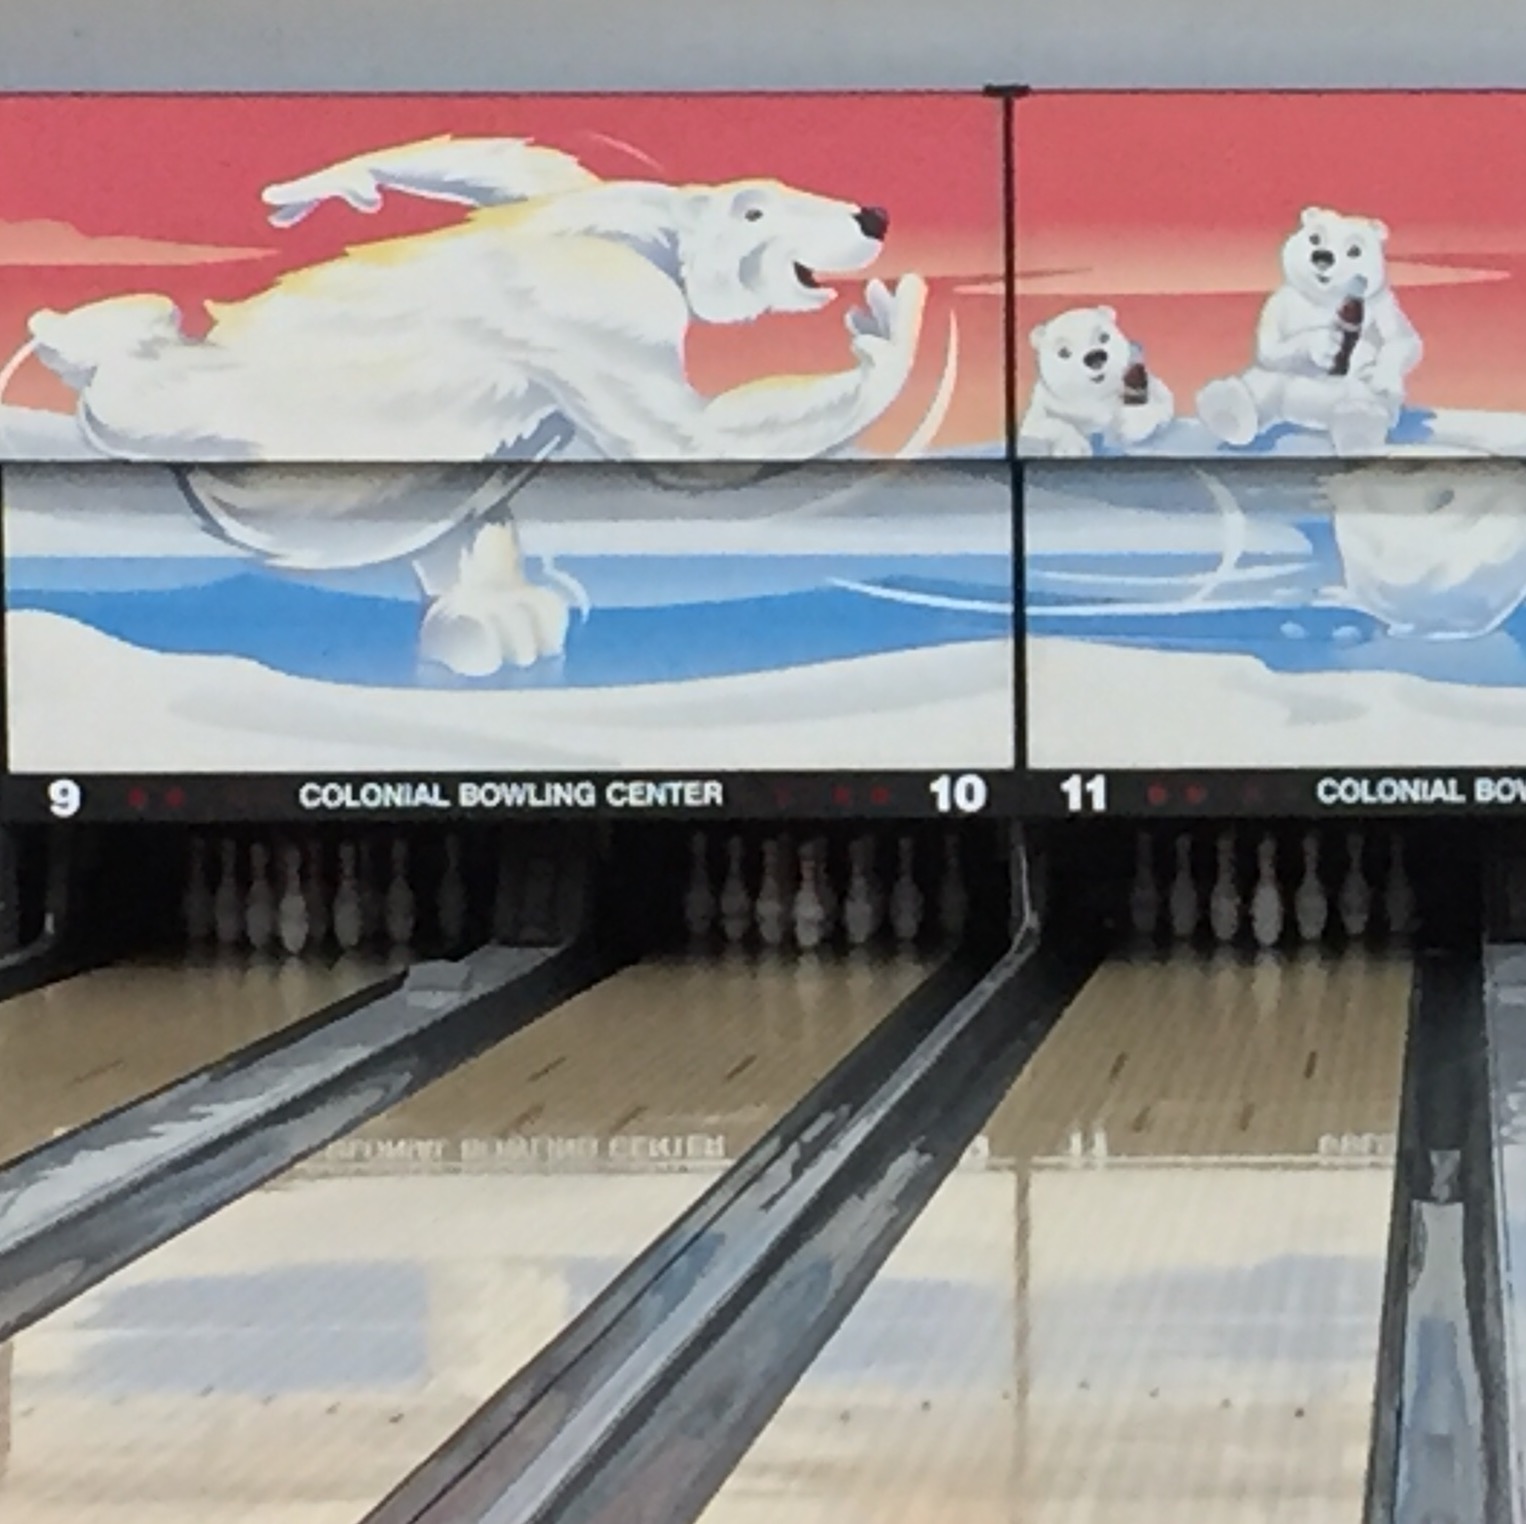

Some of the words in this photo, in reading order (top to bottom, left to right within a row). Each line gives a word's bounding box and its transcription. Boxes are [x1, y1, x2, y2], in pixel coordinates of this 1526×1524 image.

[49, 779, 80, 818] 9
[299, 782, 450, 810] COLONIAL
[459, 782, 596, 809] BOWLING
[605, 780, 723, 808] CENTER
[930, 775, 986, 813] 10
[1060, 775, 1106, 812] 11
[1317, 777, 1466, 804] COLONIAL
